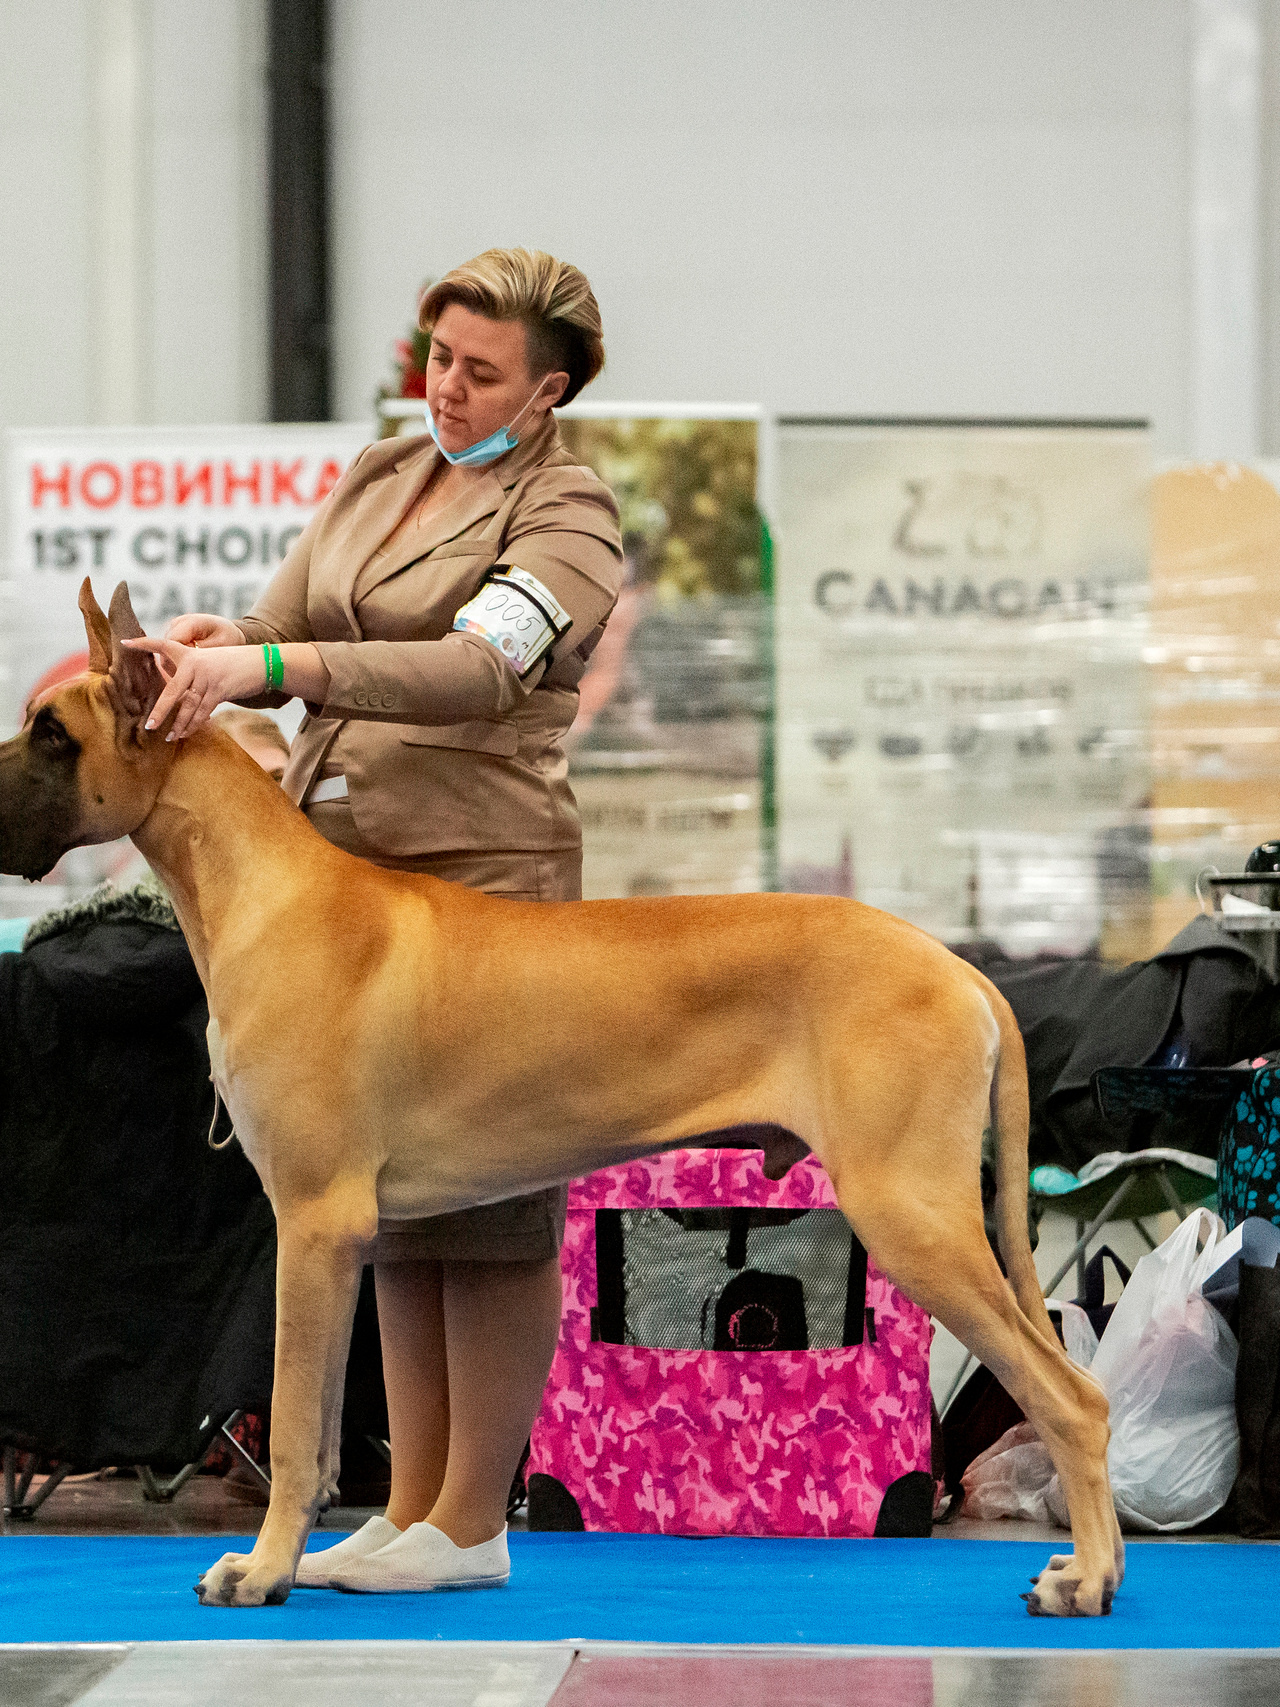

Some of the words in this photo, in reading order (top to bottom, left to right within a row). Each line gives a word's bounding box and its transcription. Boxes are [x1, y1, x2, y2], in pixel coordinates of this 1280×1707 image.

[30, 457, 345, 508] НОВИНКА
[32, 526, 113, 568] 1ST
[132, 524, 309, 568] CHOIC
[485, 594, 541, 631] 005
